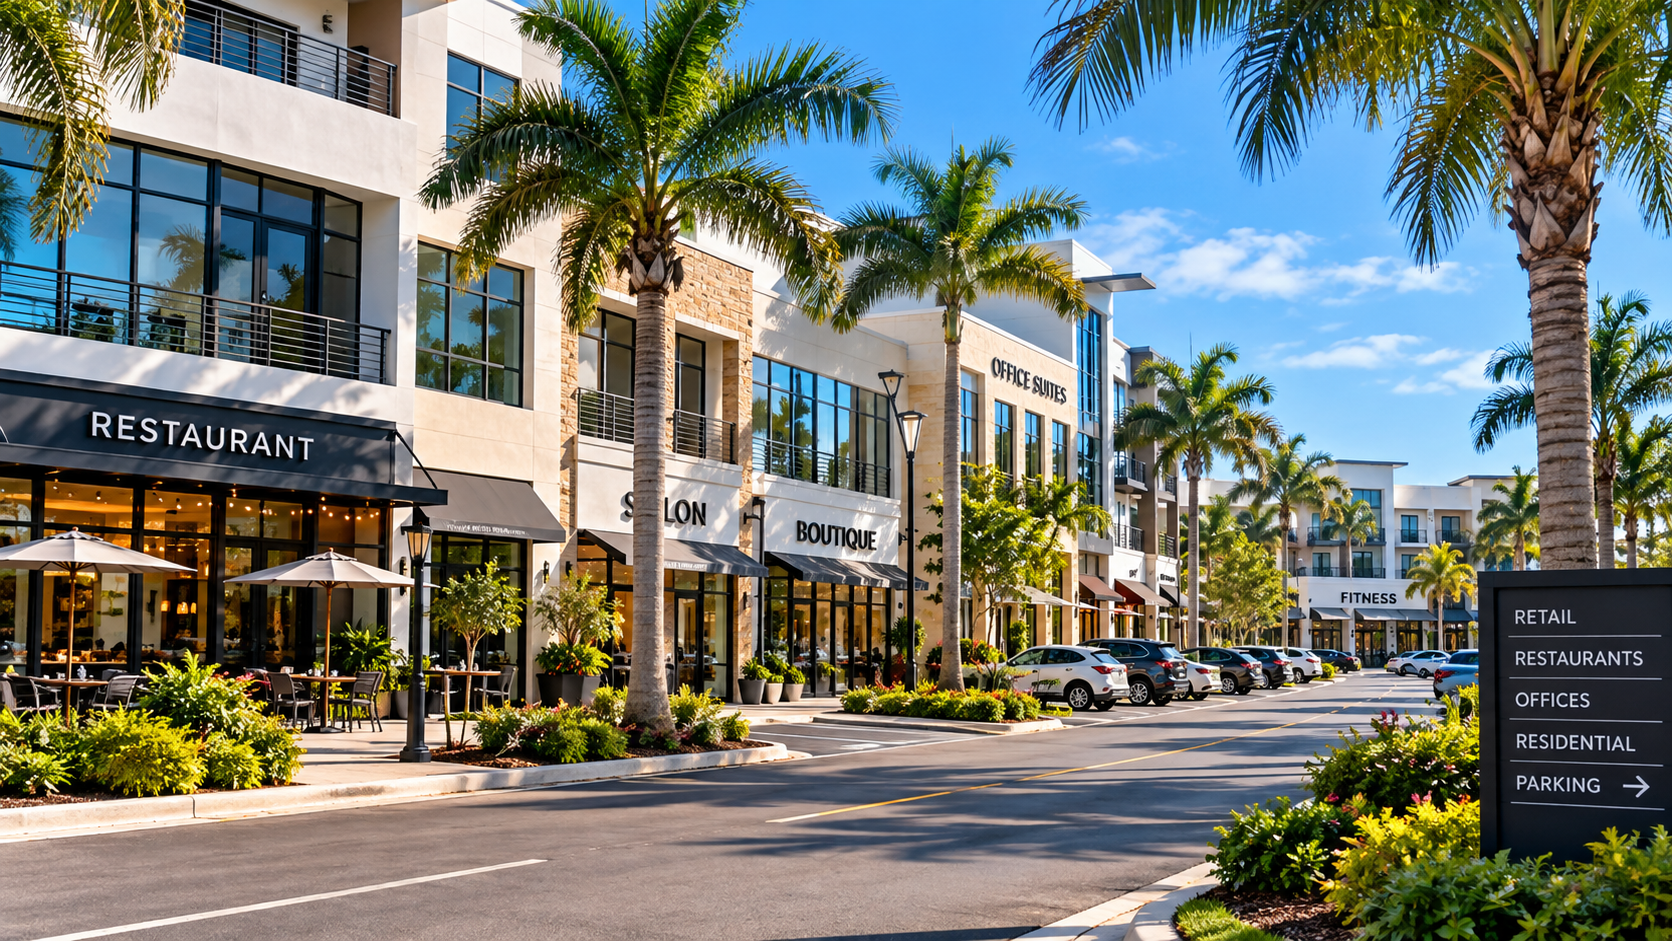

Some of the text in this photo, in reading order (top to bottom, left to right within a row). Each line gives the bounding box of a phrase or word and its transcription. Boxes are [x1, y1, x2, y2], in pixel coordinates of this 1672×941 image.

[990, 356, 1067, 405] OFFICE SUITES
[91, 411, 314, 460] RESTAURANT
[624, 491, 706, 526] SLON
[796, 520, 877, 551] BOUTIQUE
[1341, 592, 1397, 604] FITNESS
[1514, 609, 1577, 624] RETAIL
[1515, 650, 1644, 666] RESTAURANTS
[1515, 692, 1590, 708] OFFICES
[1516, 733, 1636, 752] RESIDENTIAL
[1516, 775, 1601, 793] PARKING
